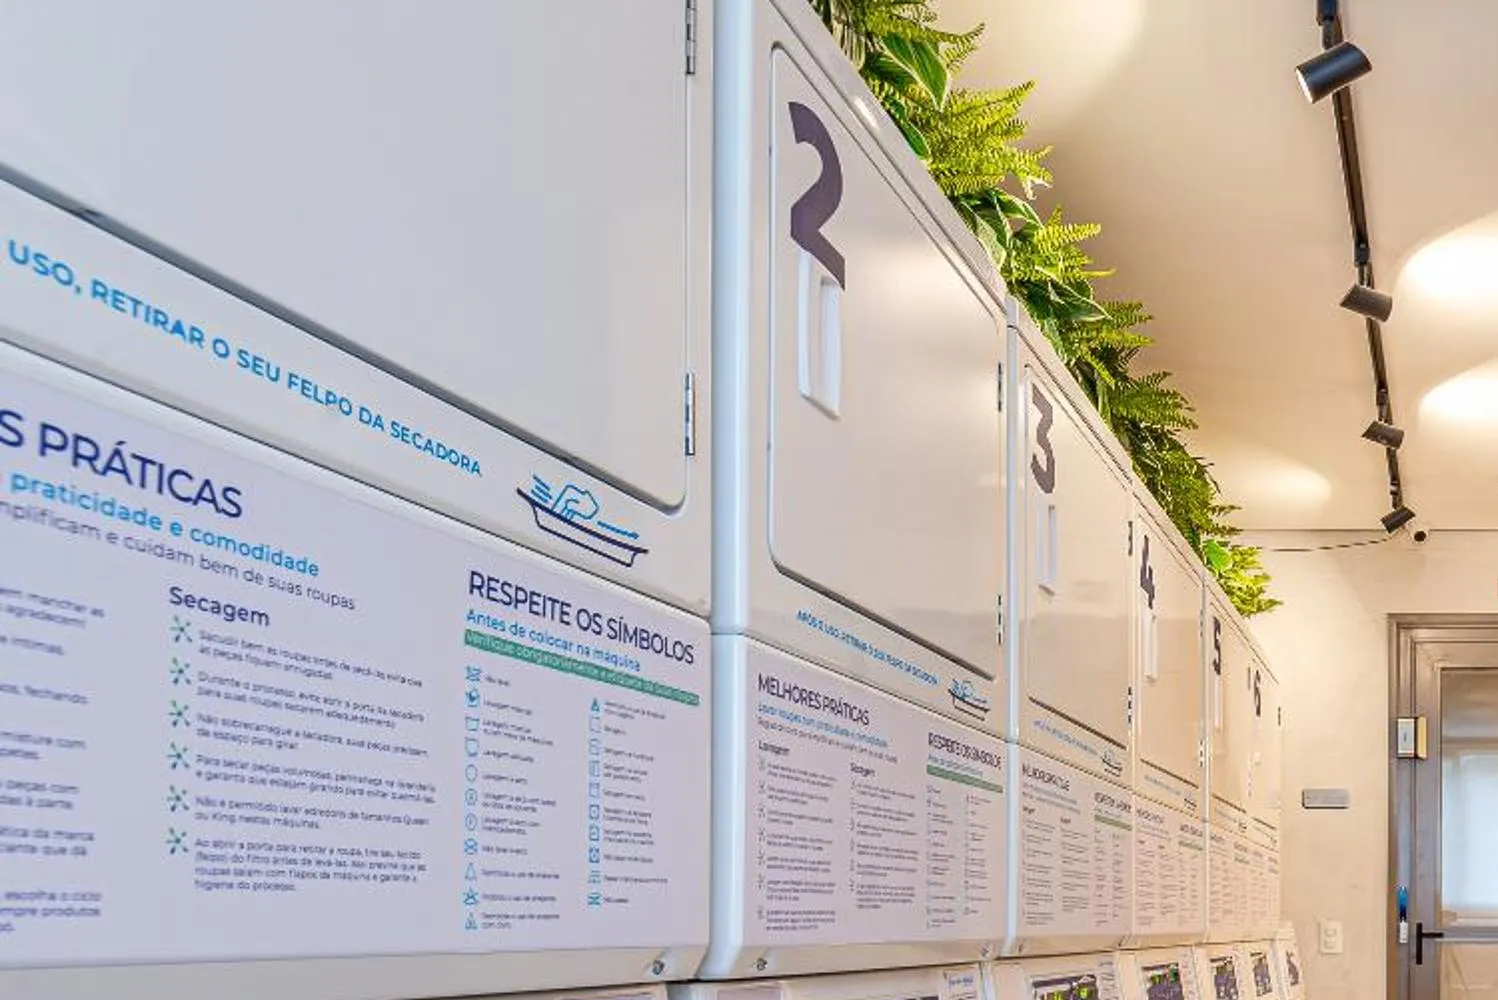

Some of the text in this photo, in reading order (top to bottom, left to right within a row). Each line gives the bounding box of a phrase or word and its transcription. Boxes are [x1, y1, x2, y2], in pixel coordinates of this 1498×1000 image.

[788, 101, 846, 292] 2
[8, 239, 482, 477] USO, RETIRAR O SEU FELPO DA SECADORA
[38, 421, 242, 518] PRÁTICAS
[1029, 382, 1056, 494] 3
[10, 471, 319, 577] praticidade e comodidade
[123, 533, 194, 567] cuidam
[200, 554, 238, 580] bem
[243, 564, 264, 586] de
[268, 575, 302, 596] suas
[306, 586, 355, 611] roupas
[168, 585, 270, 628] Secagem
[1140, 534, 1155, 610] 4
[466, 609, 506, 633] Antes
[508, 621, 525, 638] de
[529, 627, 575, 650] colocar
[577, 641, 590, 656] na
[468, 570, 694, 665] RESPEITE OS SÍMBOLOS
[1213, 616, 1221, 675] 5
[758, 673, 869, 726] MELHORES PRÁTICAS
[1253, 670, 1261, 717] 6
